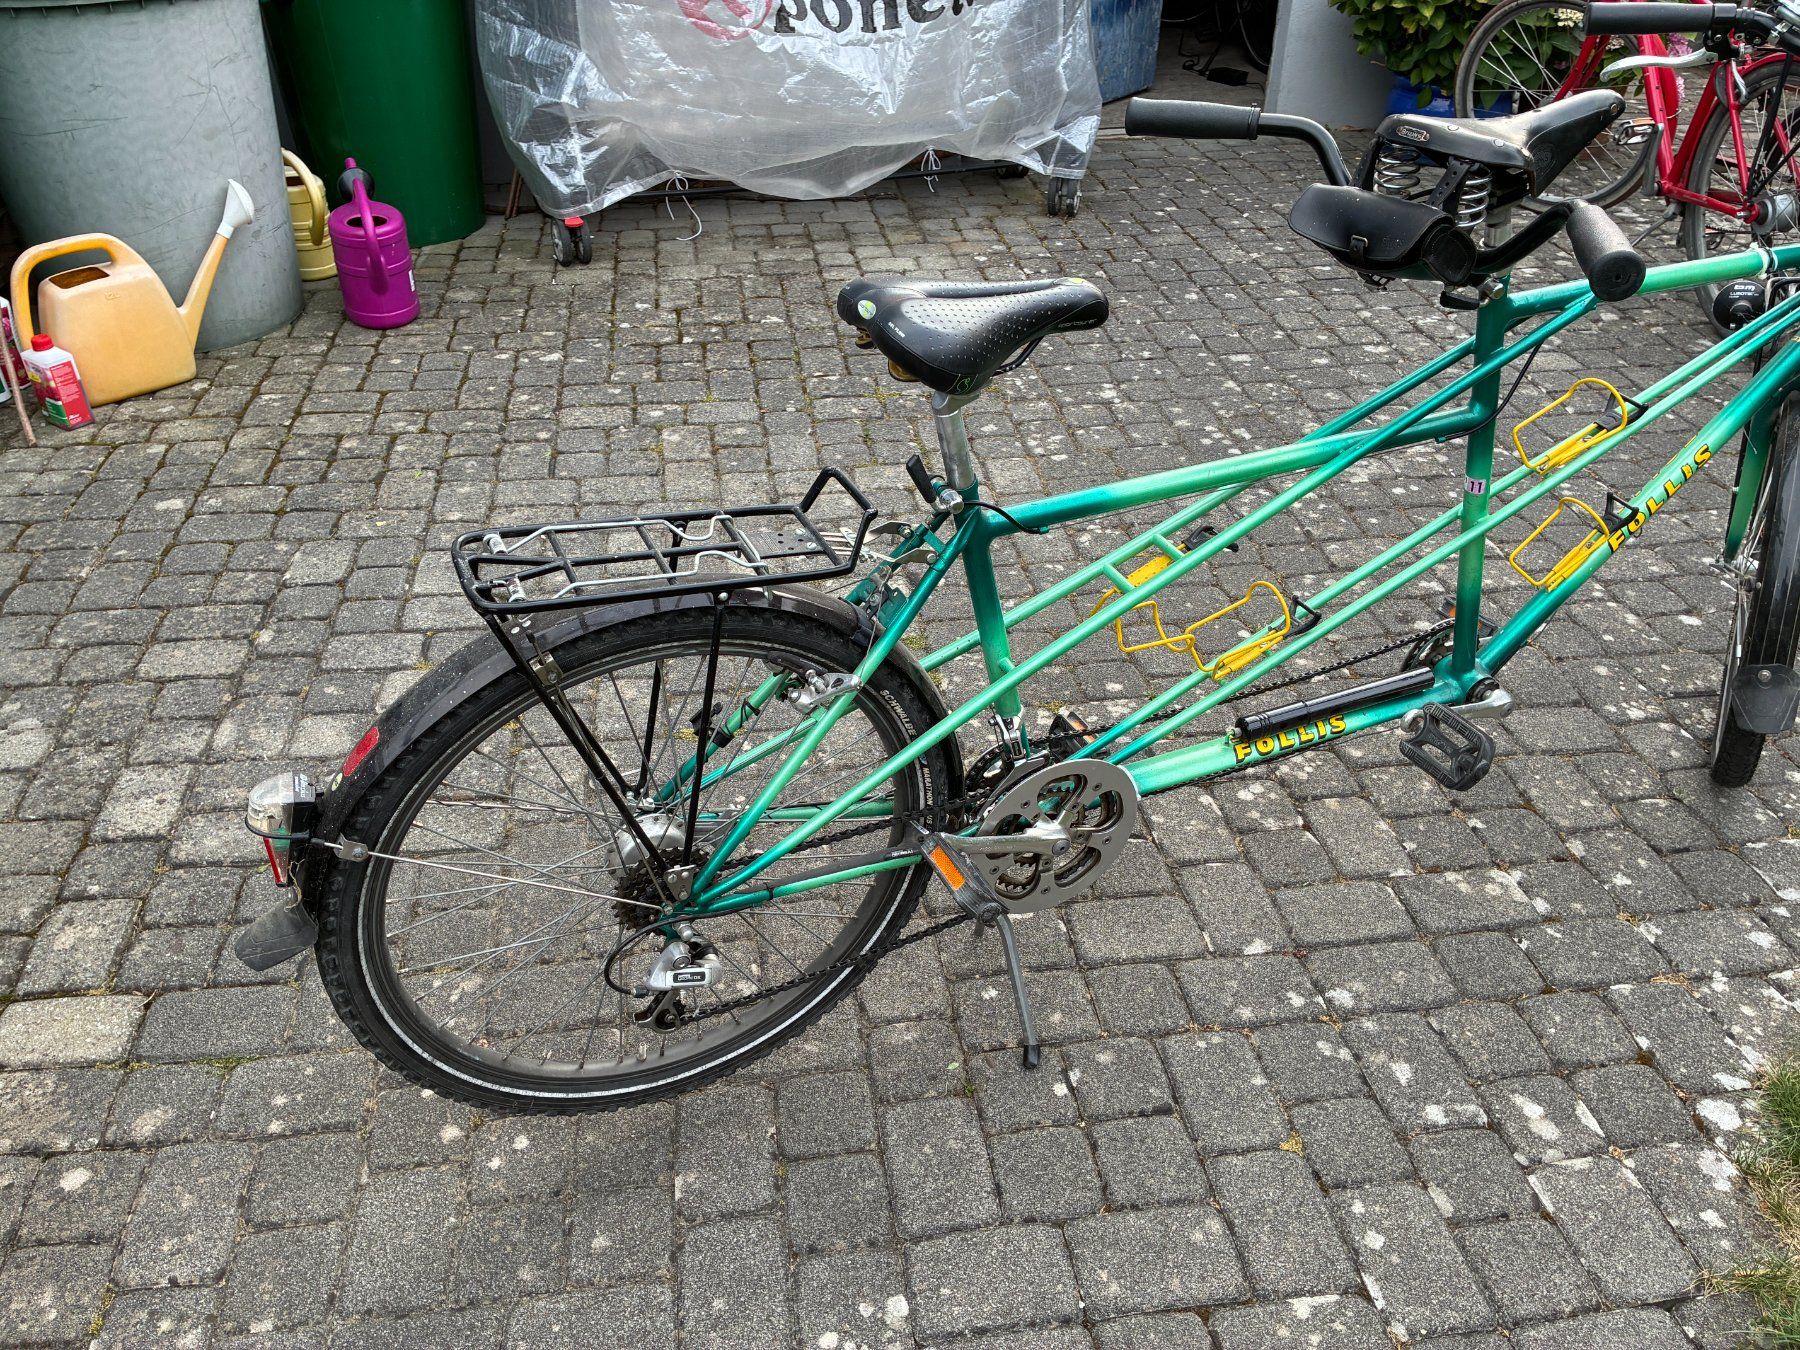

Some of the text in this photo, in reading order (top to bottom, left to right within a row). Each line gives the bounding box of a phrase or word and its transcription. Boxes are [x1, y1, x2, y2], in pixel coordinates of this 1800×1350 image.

[1608, 443, 1712, 554] FOLLIS
[879, 689, 918, 736] SCHWALBE
[1233, 713, 1347, 764] FOLLIS
[922, 766, 934, 806] MARATHON
